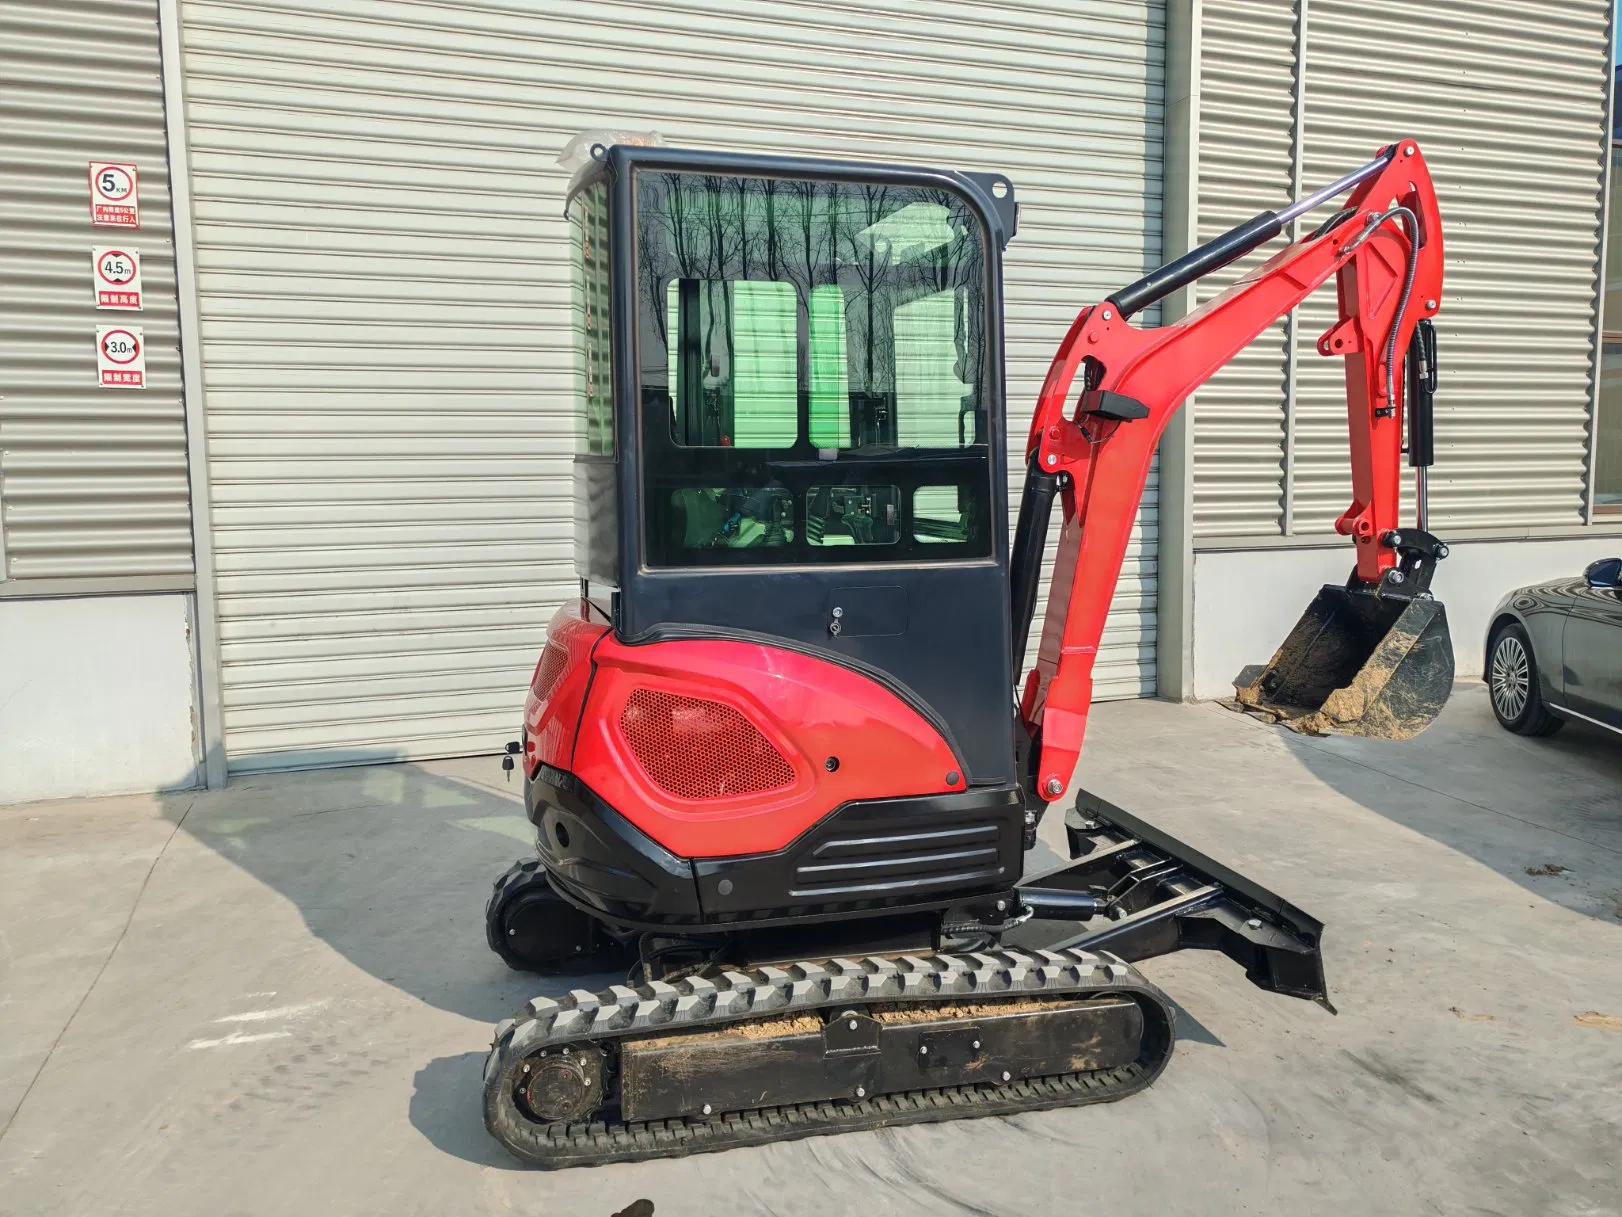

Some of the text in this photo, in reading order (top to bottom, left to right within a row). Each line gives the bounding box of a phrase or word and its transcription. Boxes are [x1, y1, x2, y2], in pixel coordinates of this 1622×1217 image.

[104, 261, 131, 275] 4.5m
[100, 294, 138, 304] 限制高度
[110, 341, 133, 353] 3.0m
[103, 372, 141, 382] 限制宽度
